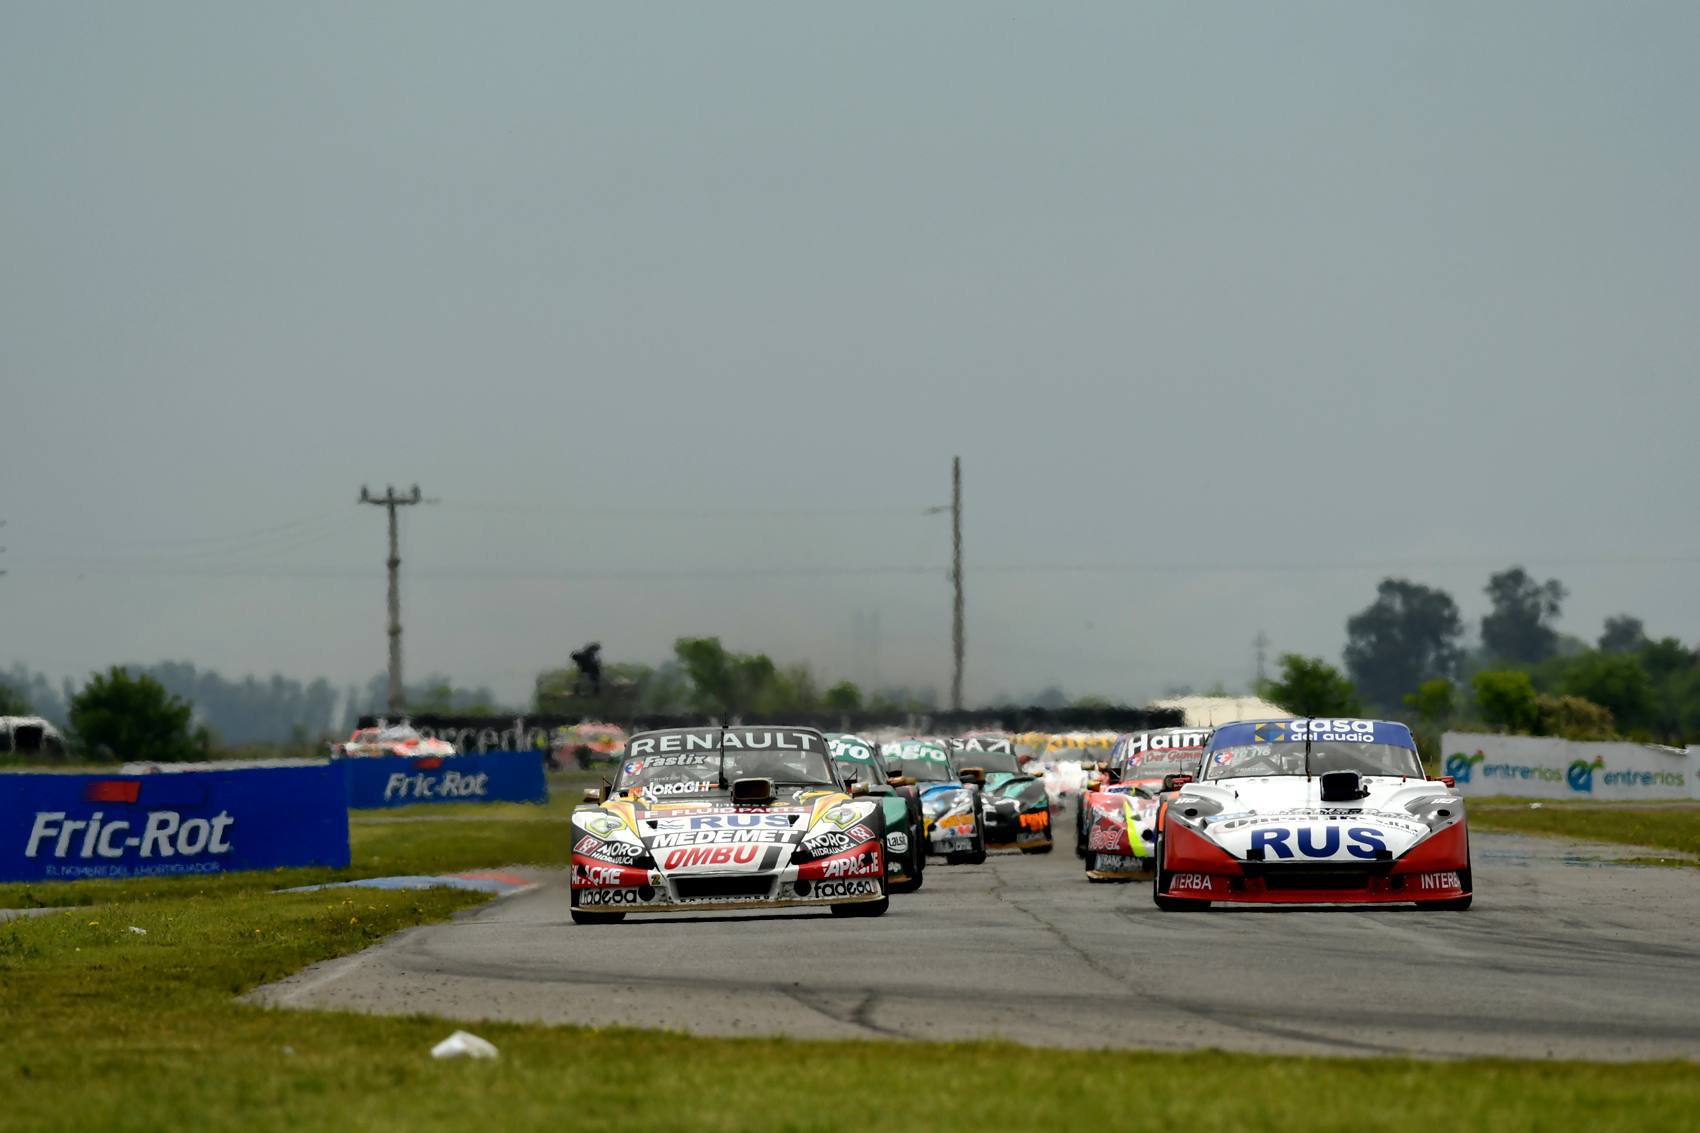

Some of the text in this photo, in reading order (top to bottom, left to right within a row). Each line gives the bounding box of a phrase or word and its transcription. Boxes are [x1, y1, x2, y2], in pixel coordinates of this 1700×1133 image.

[1290, 720, 1374, 733] casa
[631, 732, 817, 756] RENAULT
[1323, 733, 1374, 743] audio
[385, 771, 488, 799] Fric-Rot
[690, 814, 789, 829] RUS
[25, 809, 234, 858] Fric-Rot
[652, 831, 799, 848] MEDEMET
[804, 832, 850, 850] MORO
[596, 842, 642, 857] MORO
[1251, 827, 1387, 859] RUS
[664, 845, 759, 870] OMBU
